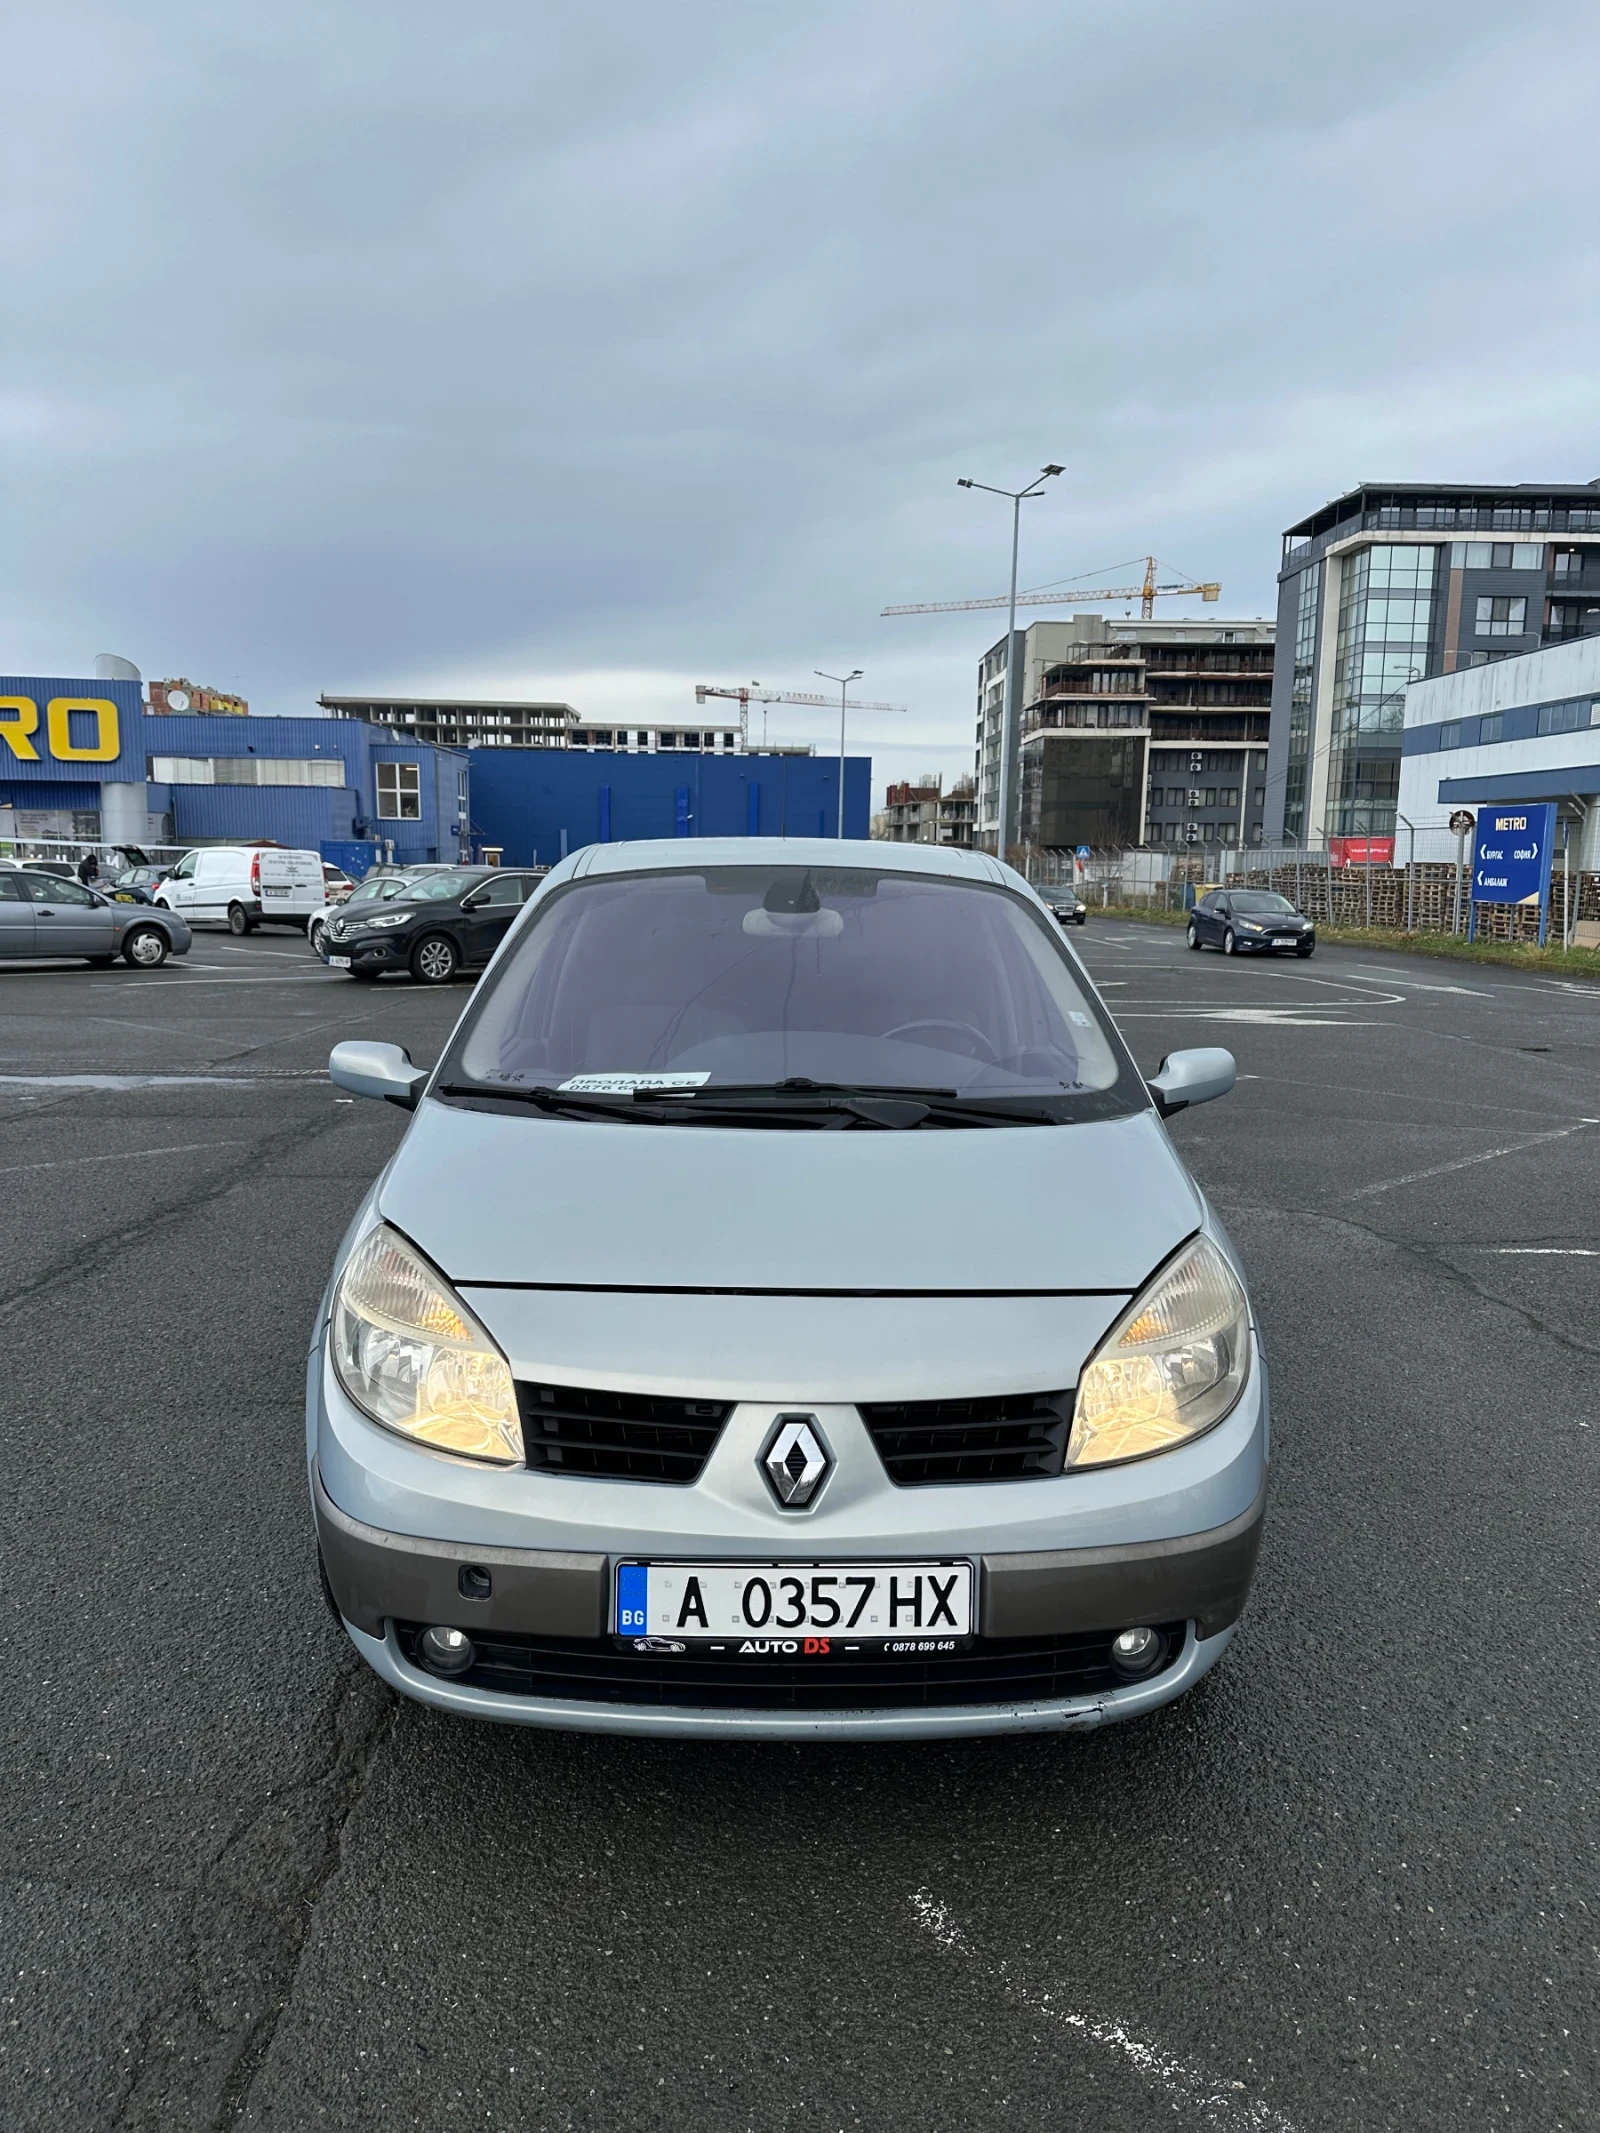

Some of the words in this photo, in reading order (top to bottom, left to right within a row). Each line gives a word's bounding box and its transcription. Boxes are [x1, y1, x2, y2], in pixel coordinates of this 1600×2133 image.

[1495, 816, 1527, 832] METRO
[1486, 850, 1504, 860] БУРГАС
[1513, 849, 1531, 861] СОФИЯ
[1483, 877, 1509, 887] АМБАЛАЖ
[676, 1576, 709, 1628] A
[741, 1576, 876, 1629] 0357
[889, 1575, 959, 1628] HX
[621, 1610, 645, 1626] BG
[738, 1640, 798, 1654] AUTO
[803, 1637, 831, 1654] DS
[892, 1642, 916, 1652] 0878
[918, 1641, 936, 1651] 699
[937, 1640, 955, 1650] 645
